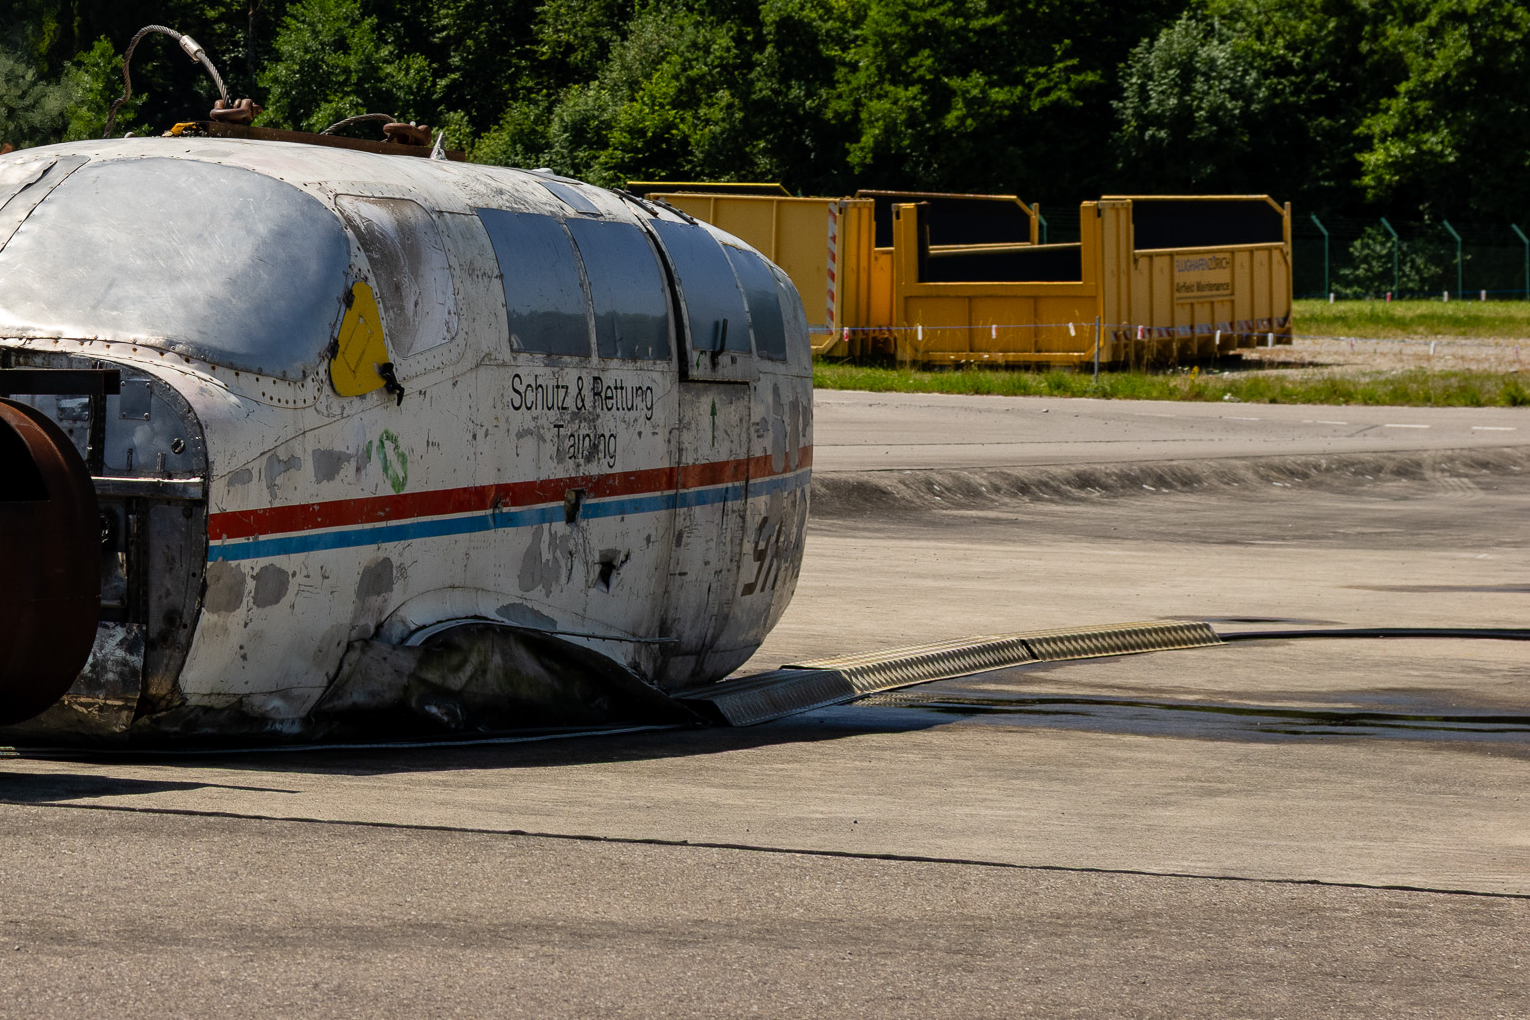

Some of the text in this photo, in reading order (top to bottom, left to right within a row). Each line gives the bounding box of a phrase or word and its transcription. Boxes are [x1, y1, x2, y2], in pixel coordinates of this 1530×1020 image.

[511, 373, 654, 421] Schutz & Rettung
[553, 423, 617, 469] Taining
